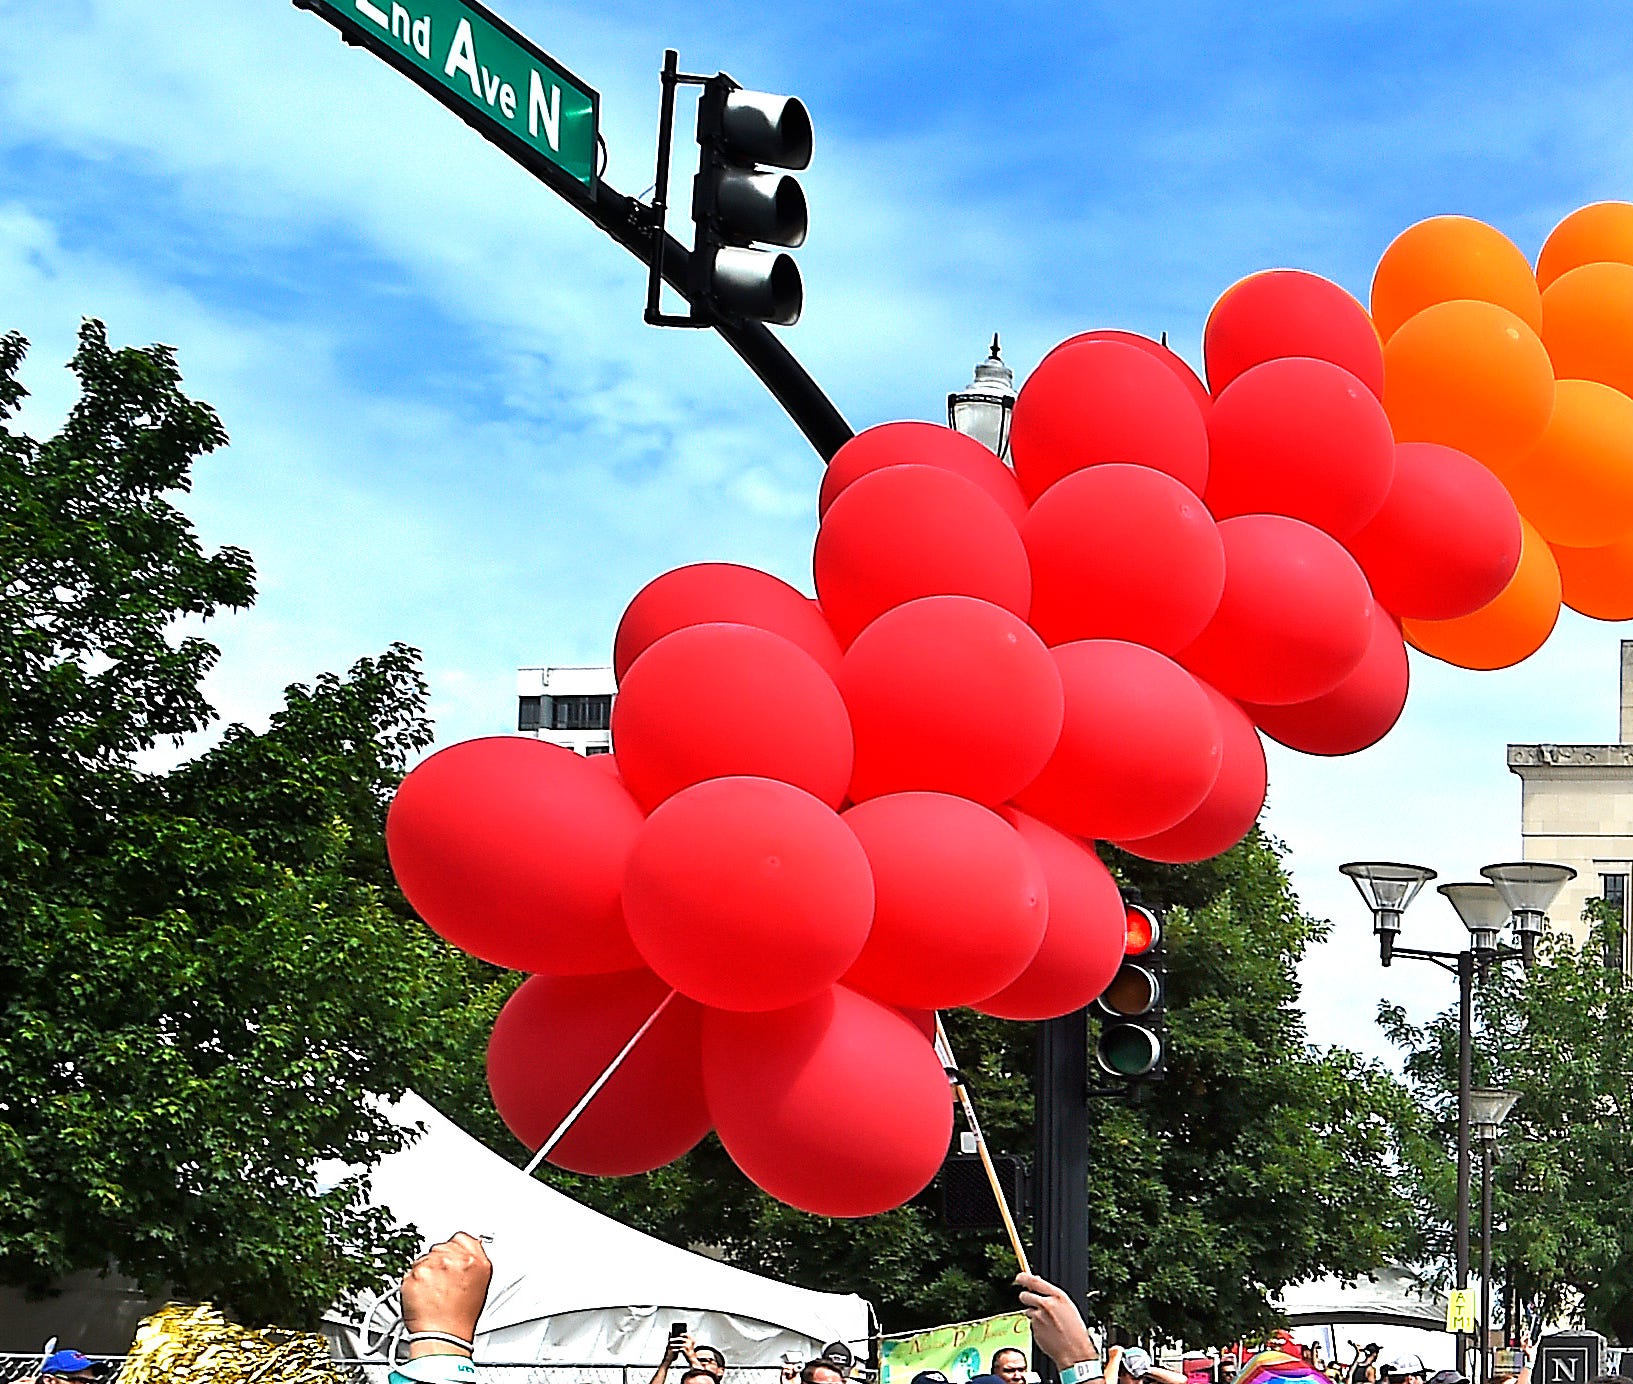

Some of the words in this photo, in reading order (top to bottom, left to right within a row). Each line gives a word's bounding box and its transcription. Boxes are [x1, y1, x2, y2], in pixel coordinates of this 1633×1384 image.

[444, 17, 517, 119] Ave
[528, 68, 561, 151] N
[1551, 1357, 1579, 1383] N
